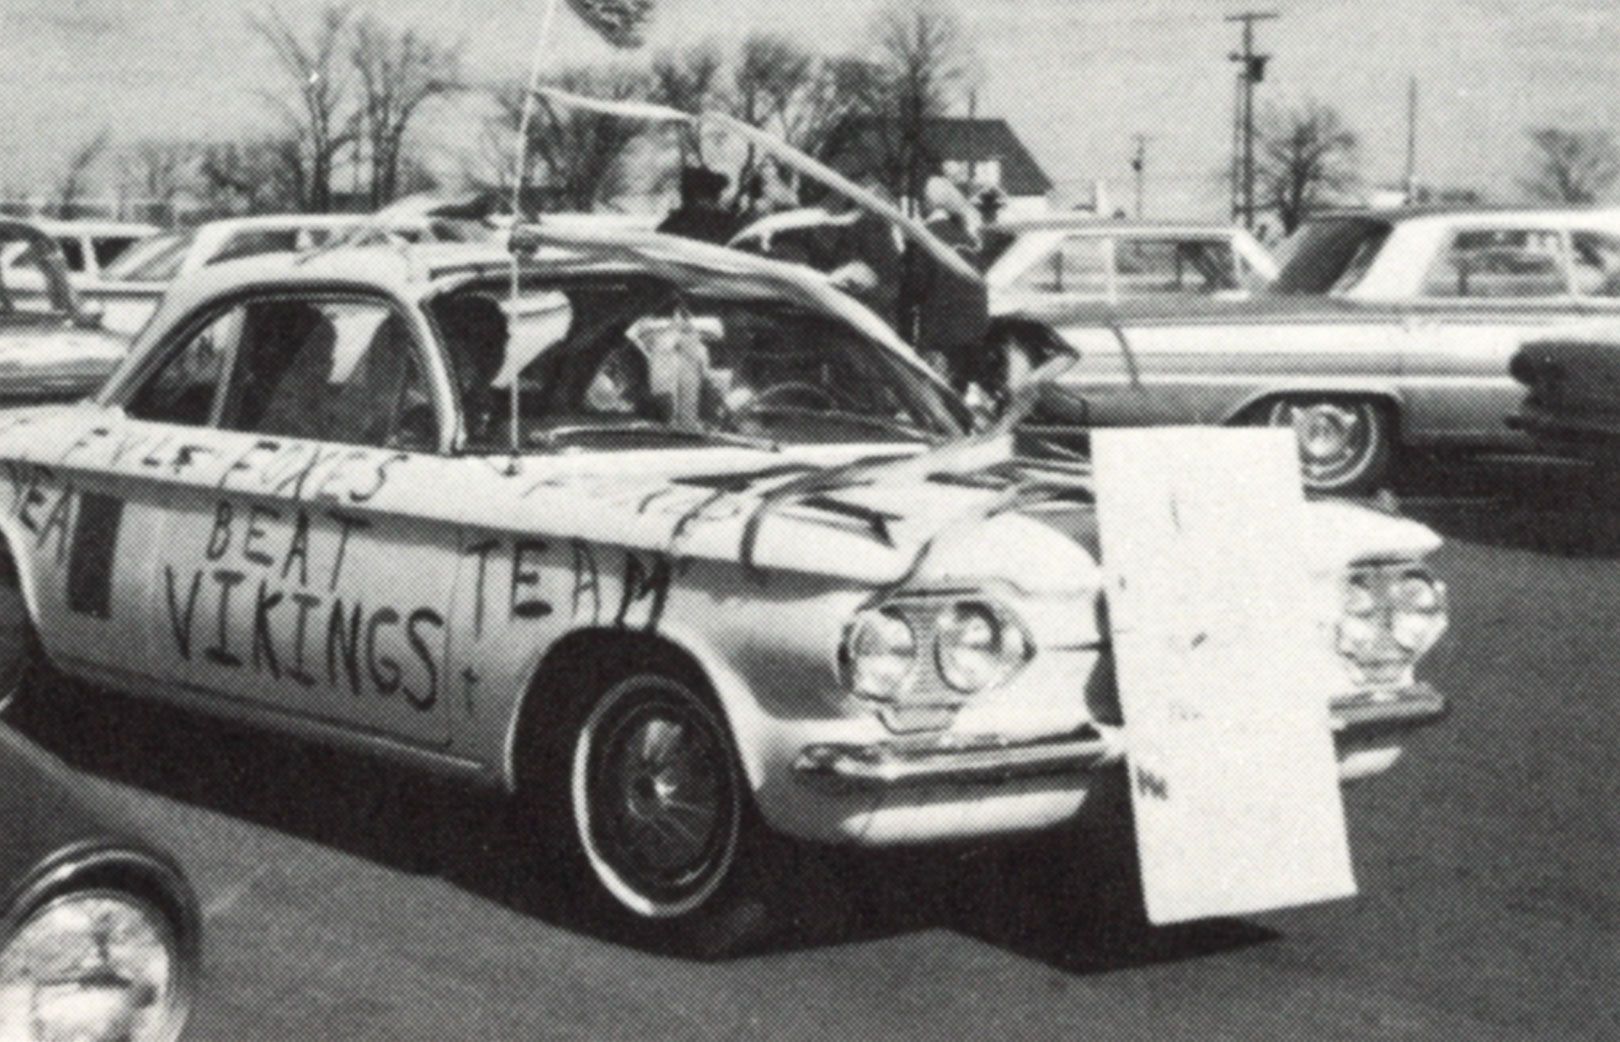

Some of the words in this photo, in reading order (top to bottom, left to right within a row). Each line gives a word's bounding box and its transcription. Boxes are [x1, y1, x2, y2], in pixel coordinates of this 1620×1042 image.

[206, 501, 371, 593] BEAT
[463, 537, 671, 643] TEAM
[165, 565, 444, 712] VIKINGS
